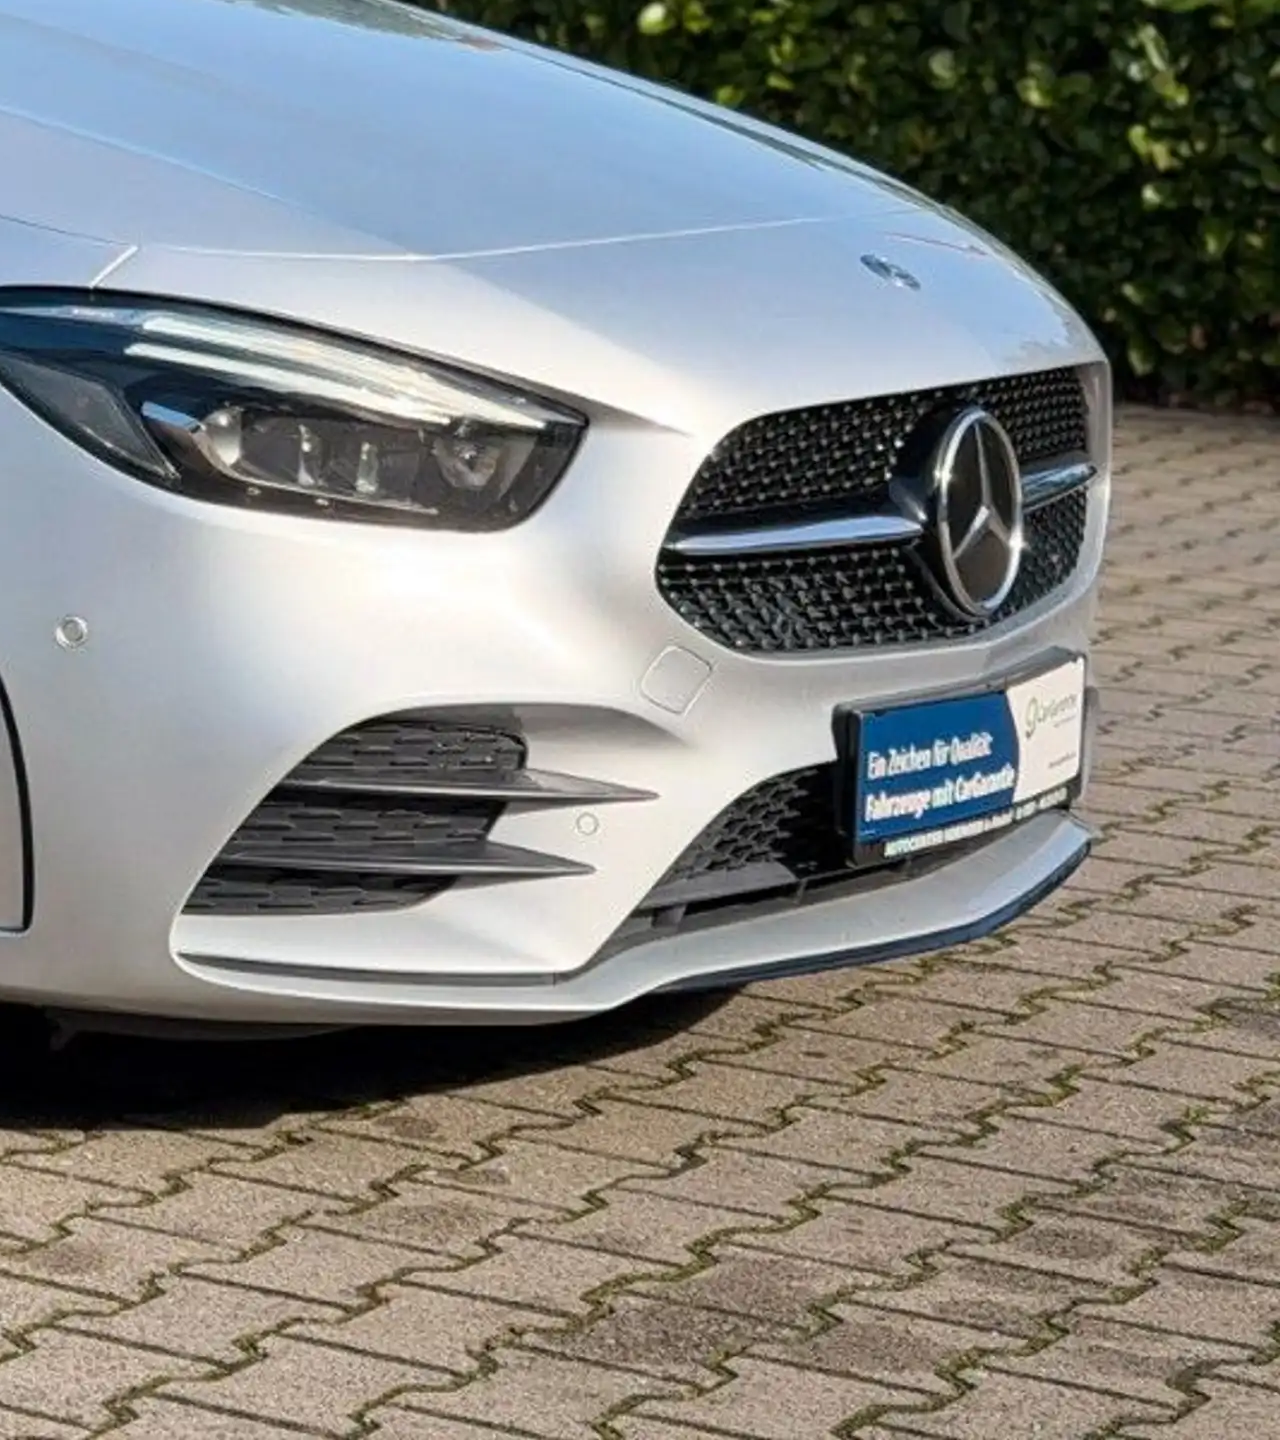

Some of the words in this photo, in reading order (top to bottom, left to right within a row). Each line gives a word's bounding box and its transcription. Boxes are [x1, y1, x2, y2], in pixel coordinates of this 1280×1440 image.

[867, 752, 886, 780] Ein
[888, 744, 931, 776] Zeichen
[933, 739, 951, 766] für
[864, 791, 931, 820] Fahrzeuge
[932, 778, 953, 808] mit
[955, 762, 1016, 801] CarGarantie
